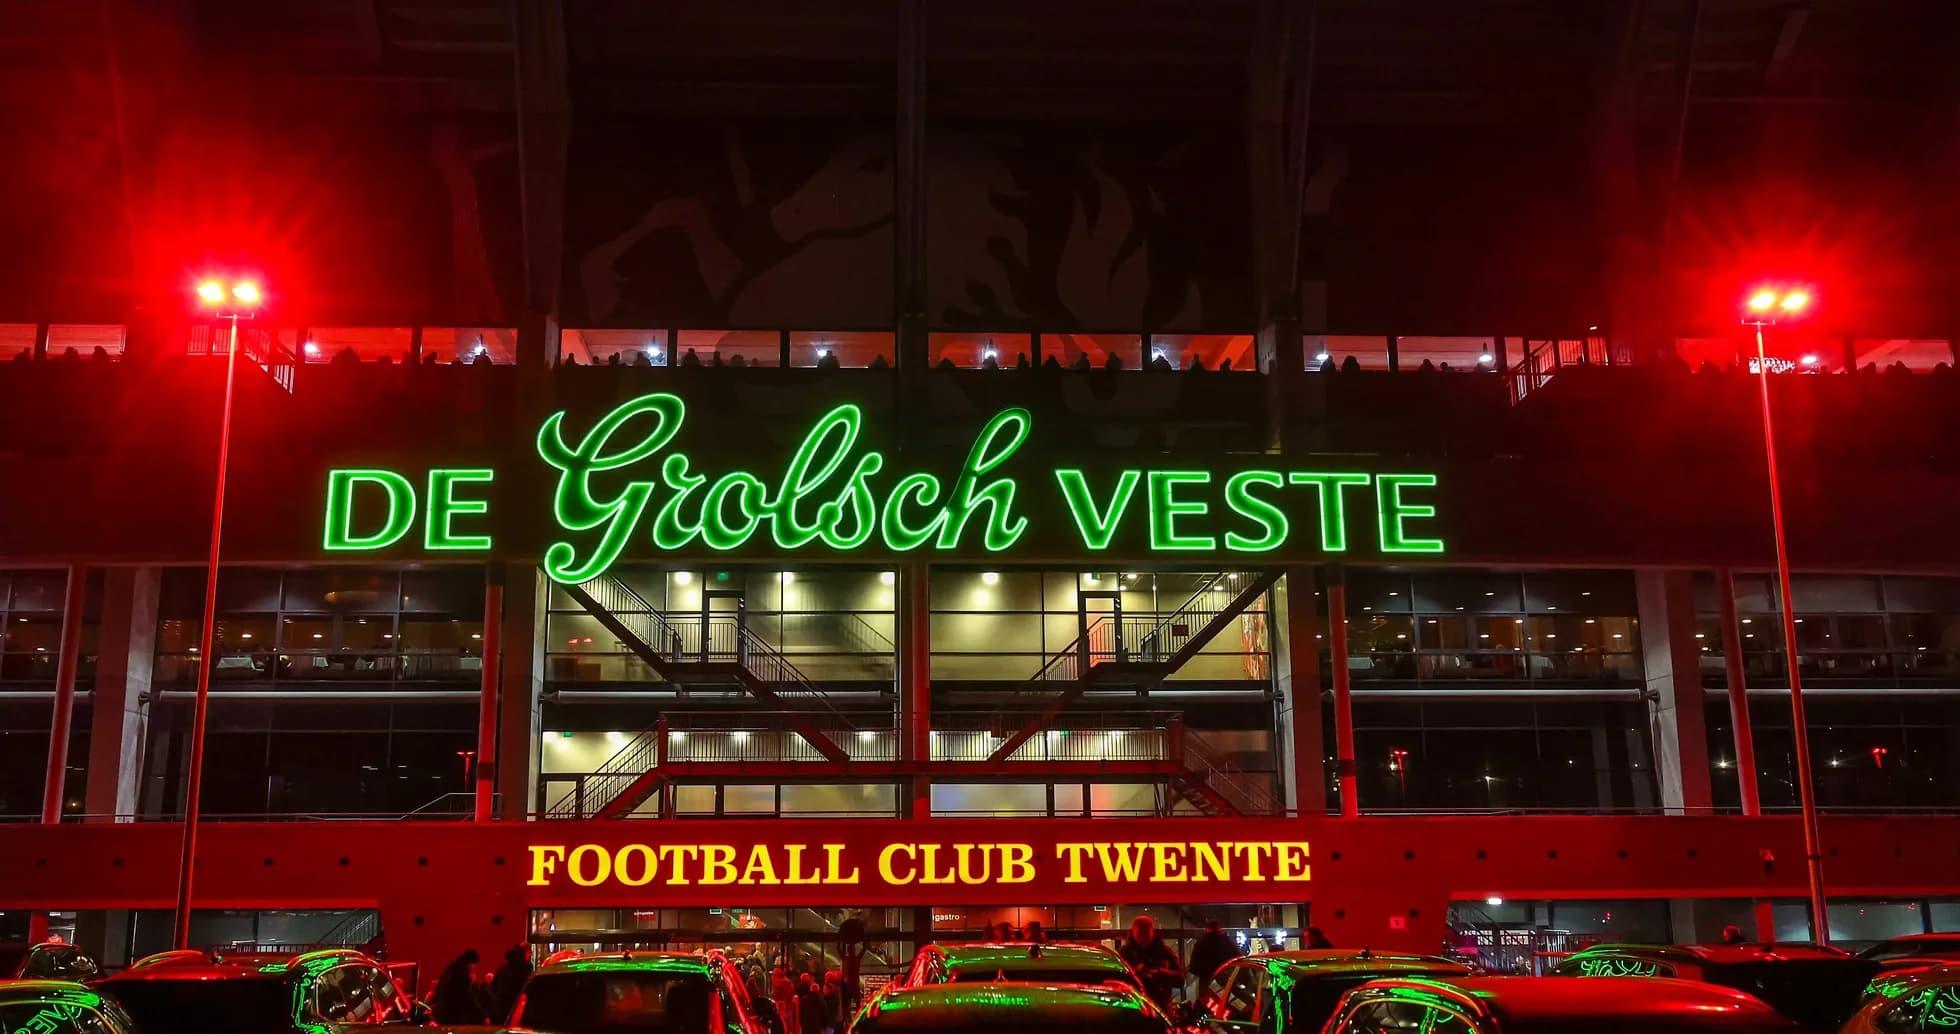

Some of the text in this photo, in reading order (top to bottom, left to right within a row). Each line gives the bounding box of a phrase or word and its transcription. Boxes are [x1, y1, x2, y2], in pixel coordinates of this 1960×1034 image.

[322, 392, 1446, 586] DE Grolsch VESTE
[526, 840, 1312, 888] FOOTBALL CLUB TWENTE
